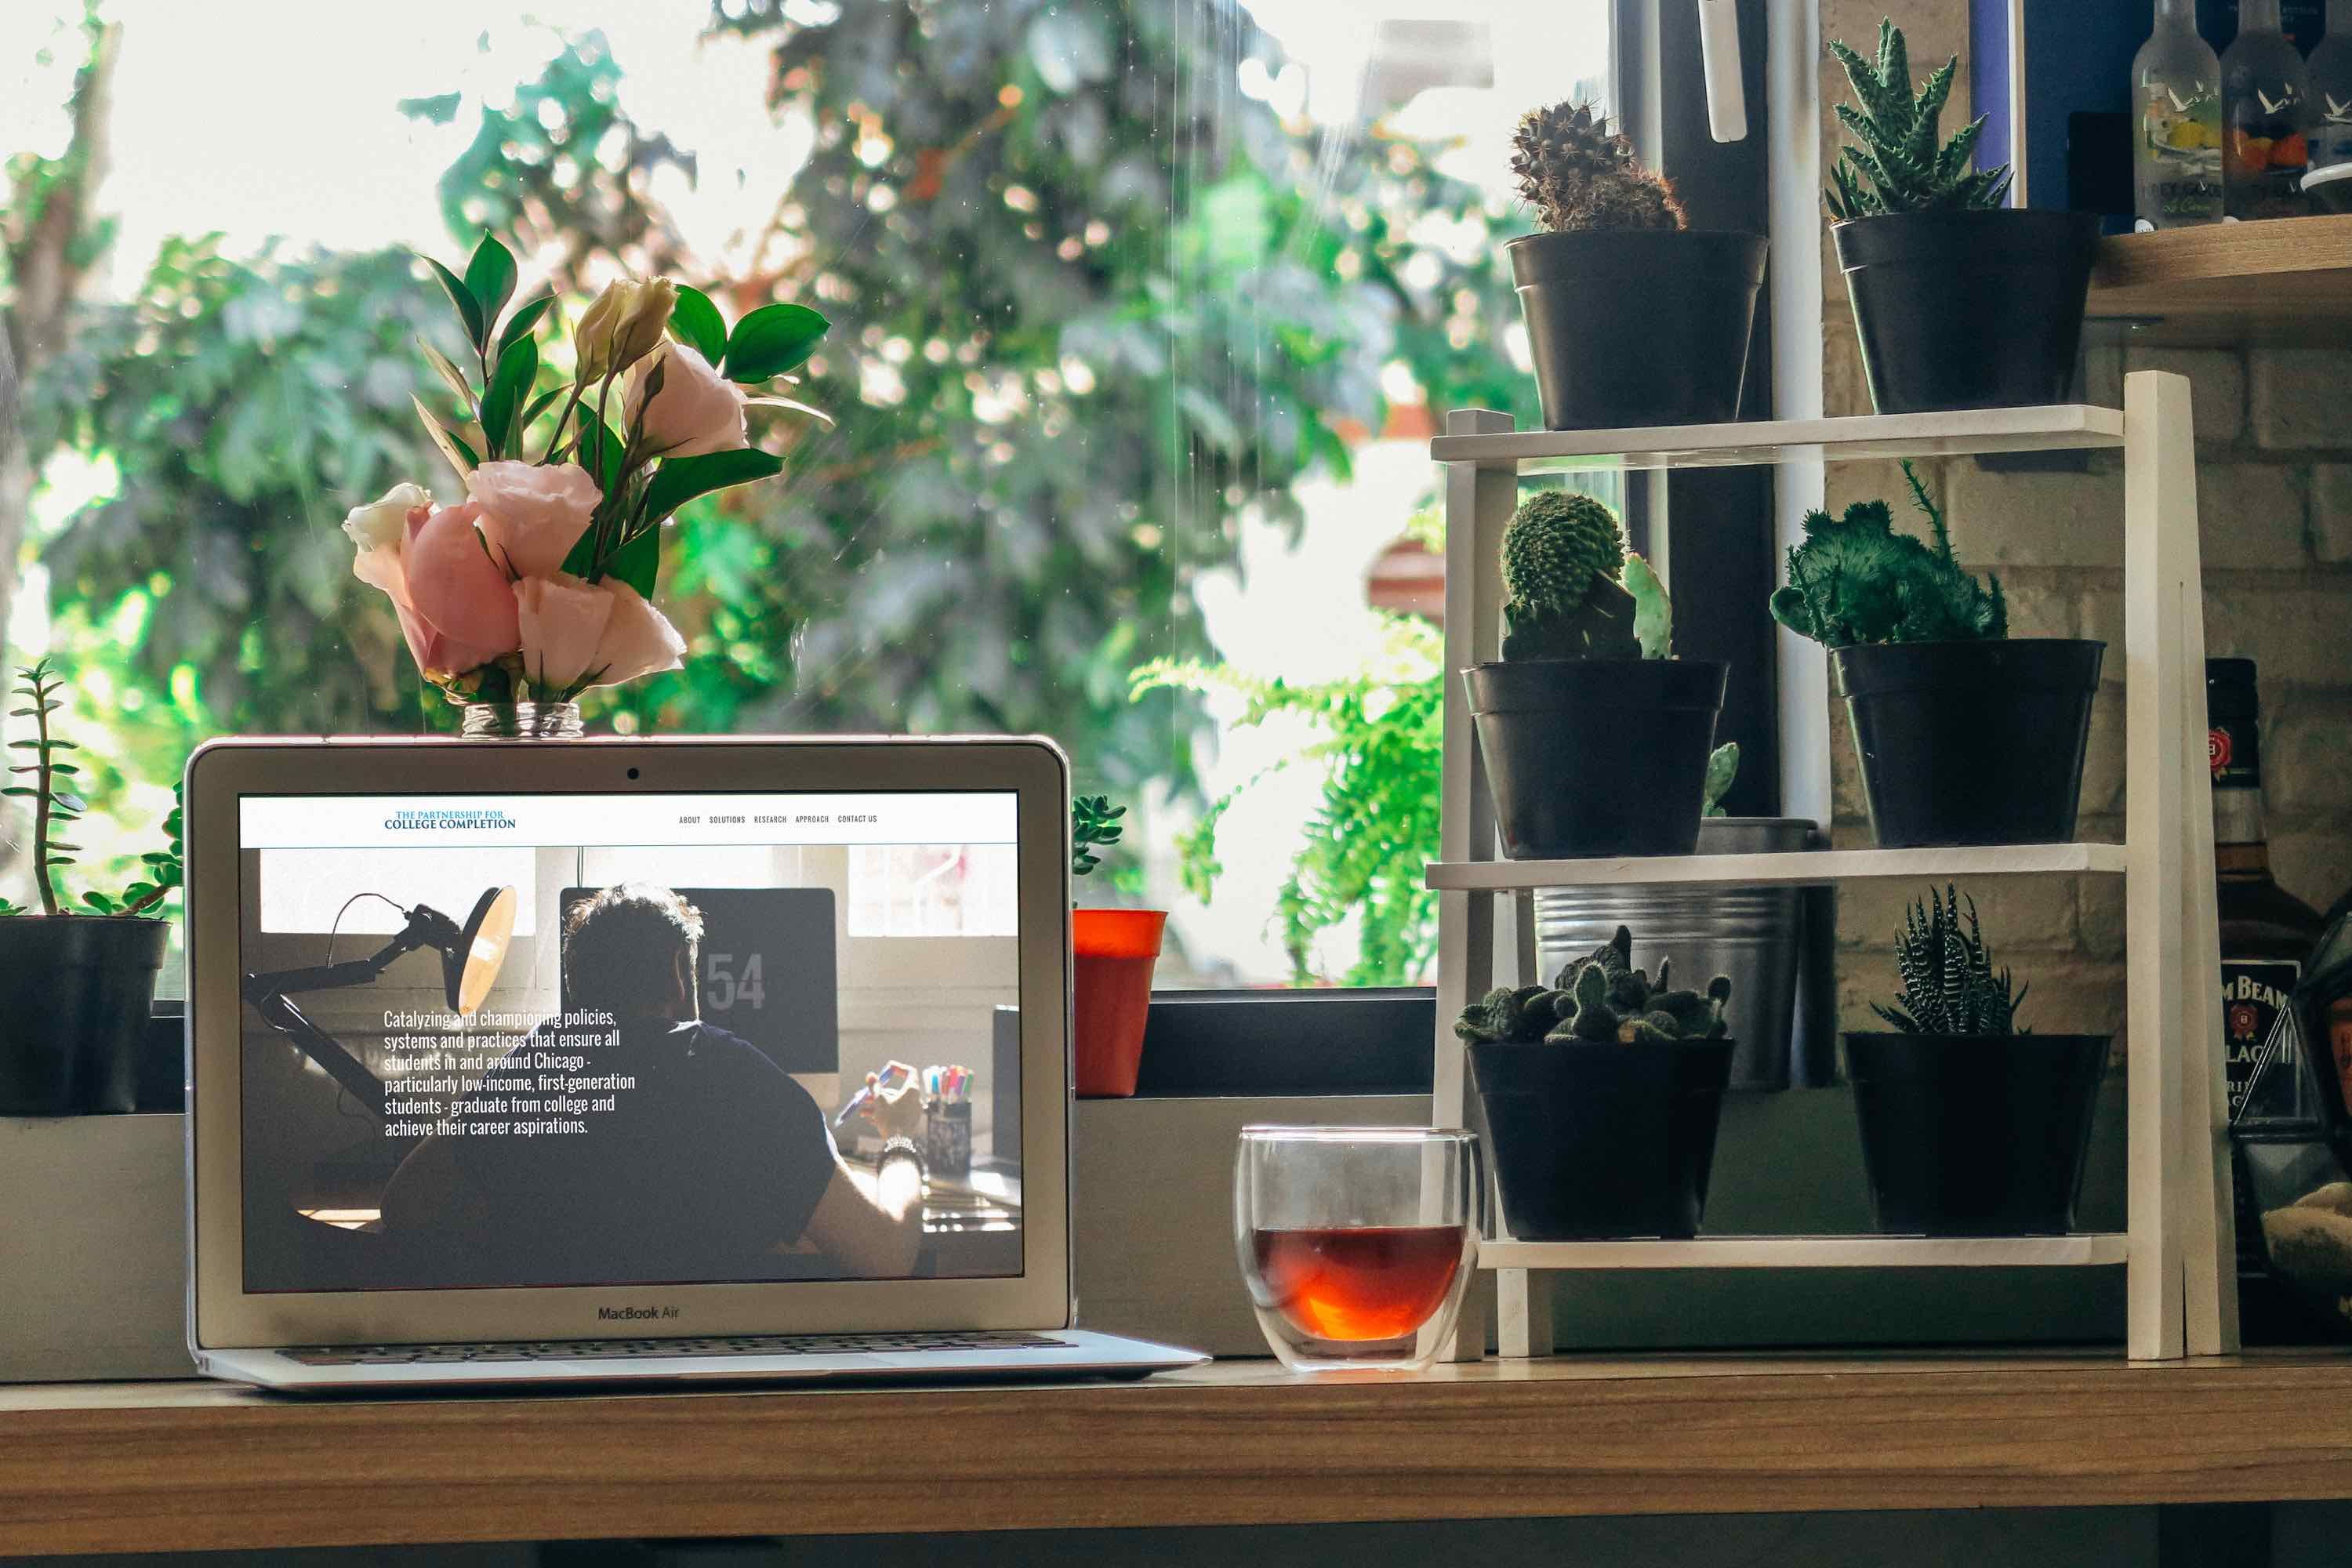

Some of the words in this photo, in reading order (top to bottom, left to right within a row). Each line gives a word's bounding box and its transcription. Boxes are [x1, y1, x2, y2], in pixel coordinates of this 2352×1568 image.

[384, 819, 437, 829] COLLEGE
[439, 818, 516, 829] COMPLETION
[395, 811, 416, 819] THE
[418, 811, 482, 819] PARTNERSHIP
[707, 953, 766, 1010] 54
[384, 1010, 451, 1029] Catalyzing
[453, 1010, 477, 1027] and
[480, 1009, 562, 1029] championing
[564, 1008, 616, 1028] policies,
[384, 1032, 439, 1051] systems
[441, 1031, 463, 1049] and
[468, 1030, 526, 1051] practices
[529, 1030, 555, 1047] that
[559, 1033, 603, 1047] ensure
[604, 1029, 620, 1047] all
[384, 1054, 441, 1071] students
[444, 1054, 456, 1070] in
[459, 1053, 483, 1070] and
[486, 1053, 531, 1069] around
[534, 1052, 584, 1072] Chicago
[384, 1076, 458, 1096] particularly
[461, 1075, 535, 1093] low-income,
[538, 1074, 636, 1093] first-generation
[384, 1098, 441, 1115] students
[451, 1097, 508, 1117] graduate
[510, 1096, 541, 1113] from
[544, 1095, 589, 1115] college
[591, 1094, 615, 1112] and
[384, 1120, 434, 1137] achieve
[436, 1119, 468, 1136] their
[470, 1121, 510, 1135] career
[514, 1118, 589, 1137] aspirations.
[598, 1306, 659, 1319] MacBook
[662, 1307, 680, 1319] Air
